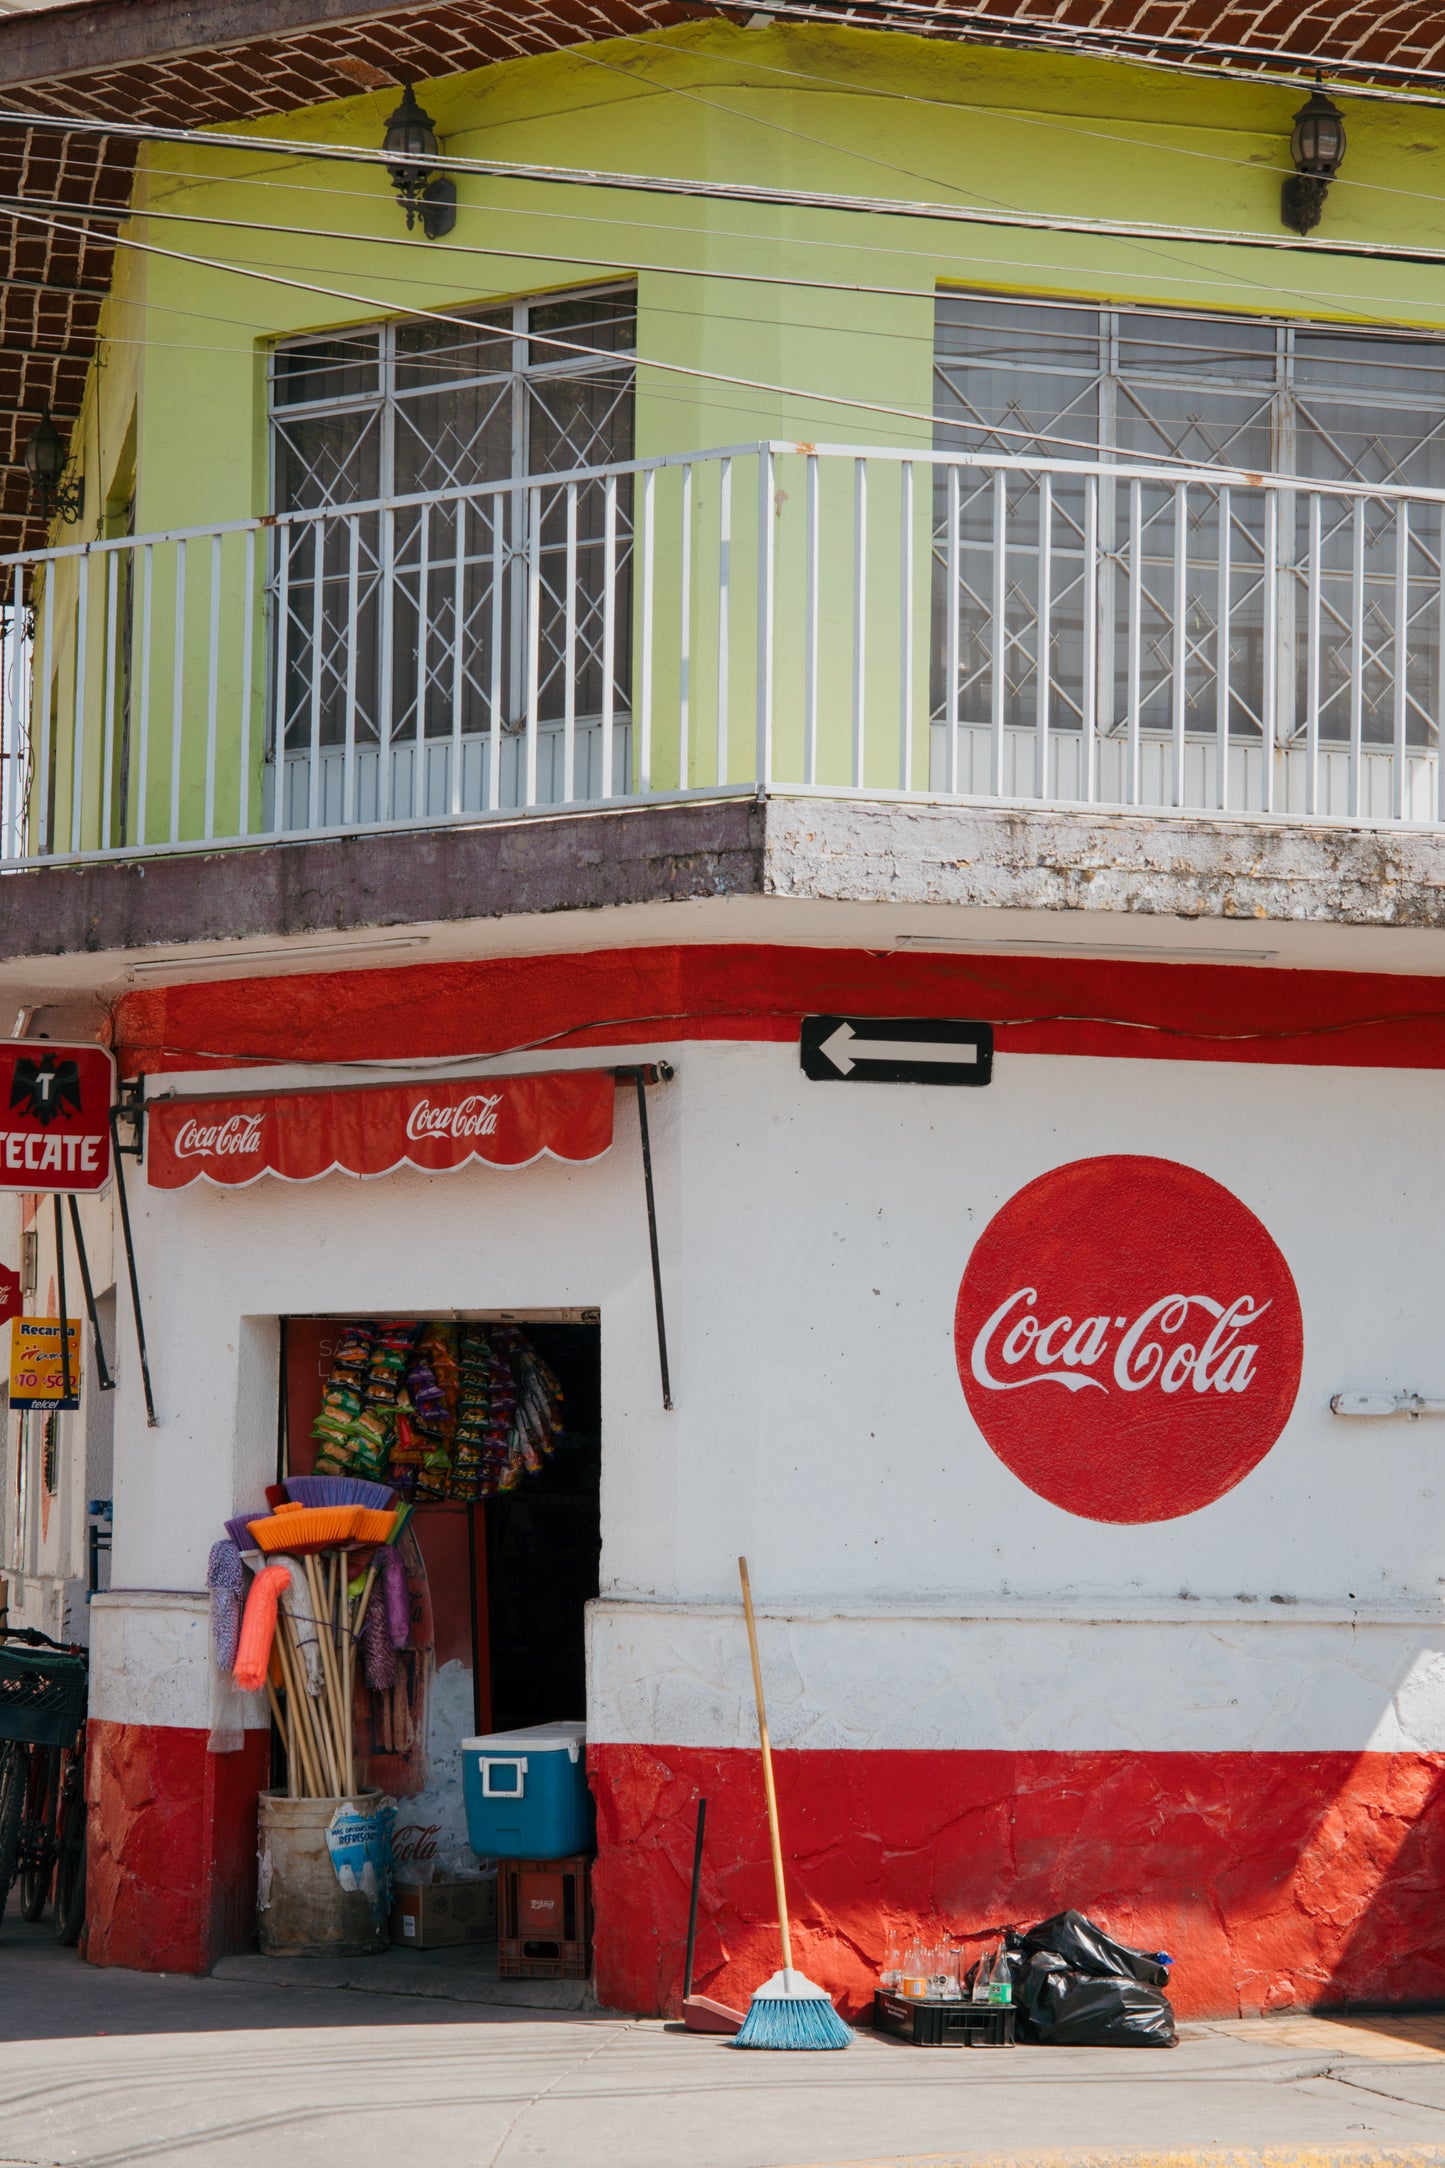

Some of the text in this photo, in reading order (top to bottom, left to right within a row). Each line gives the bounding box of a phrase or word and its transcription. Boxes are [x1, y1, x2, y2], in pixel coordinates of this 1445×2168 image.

[35, 1073, 56, 1101] T
[406, 1094, 503, 1140] Coca-Cola
[174, 1113, 266, 1159] Coca-Cola
[21, 1324, 75, 1338] Recara
[971, 1286, 1273, 1394] Coca-Cola
[31, 1399, 59, 1409] telcel
